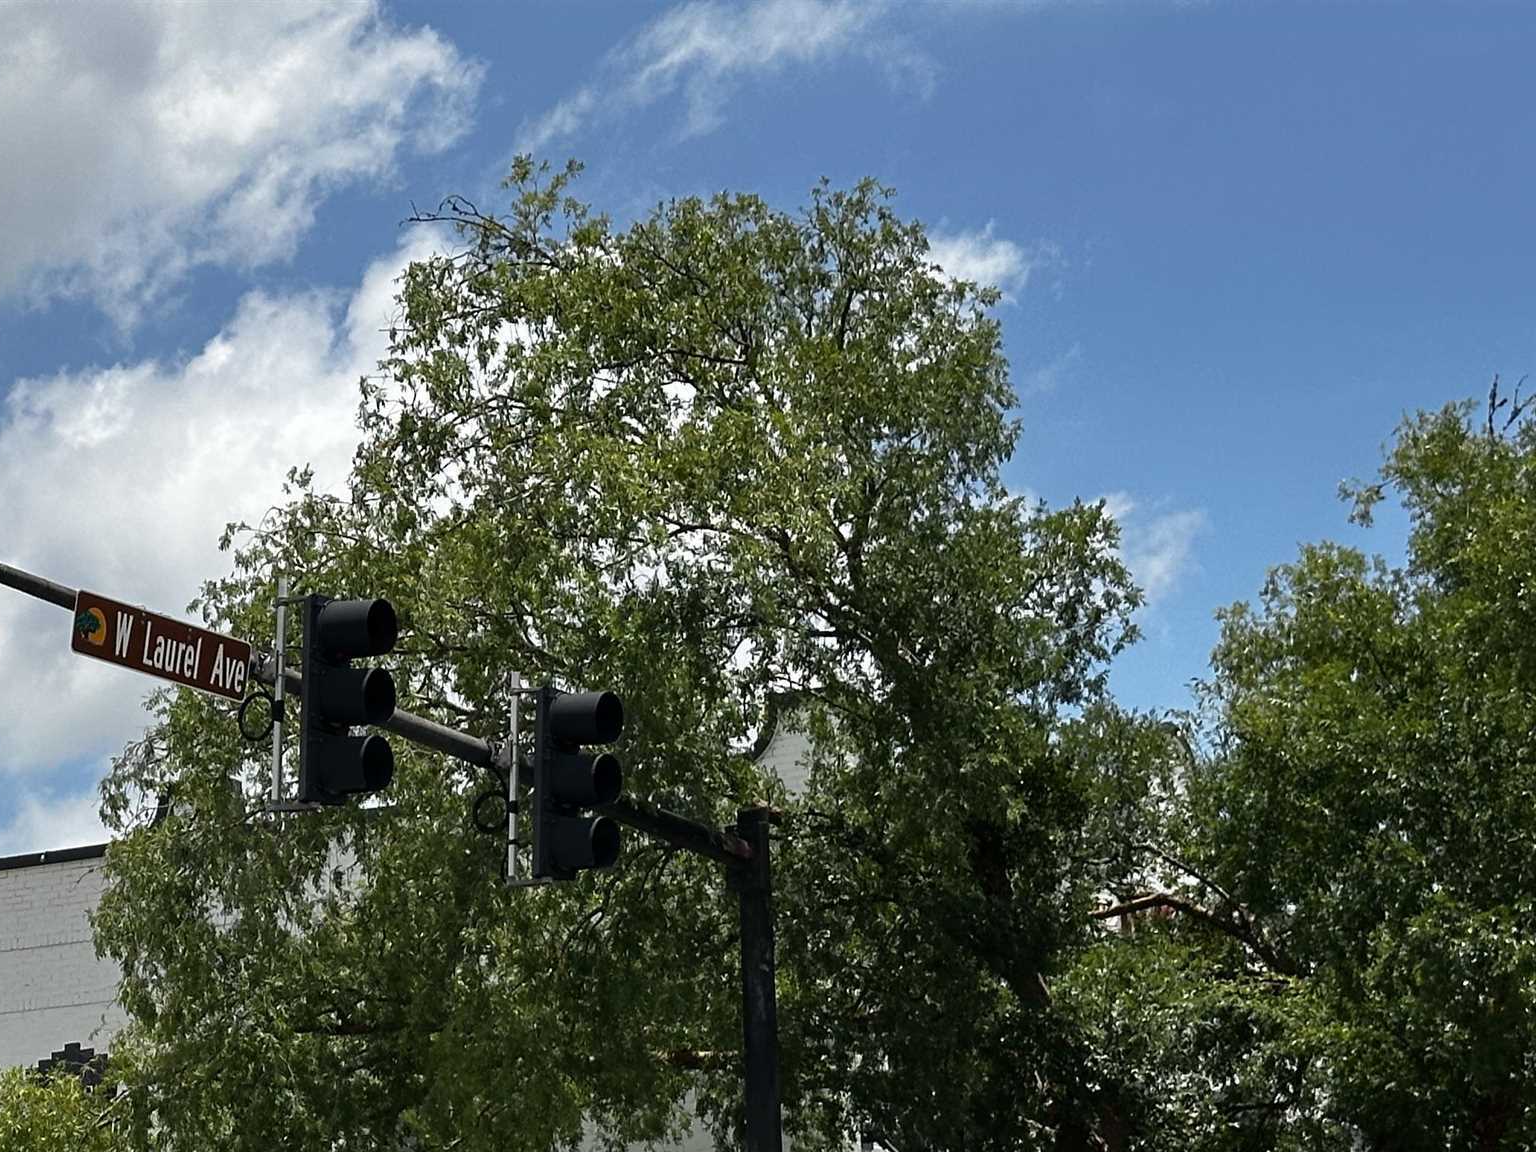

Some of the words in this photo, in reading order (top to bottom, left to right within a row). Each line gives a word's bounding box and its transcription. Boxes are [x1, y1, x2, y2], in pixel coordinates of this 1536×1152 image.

[114, 611, 133, 658] W
[142, 621, 202, 680] Laurel
[209, 643, 245, 693] Ave
